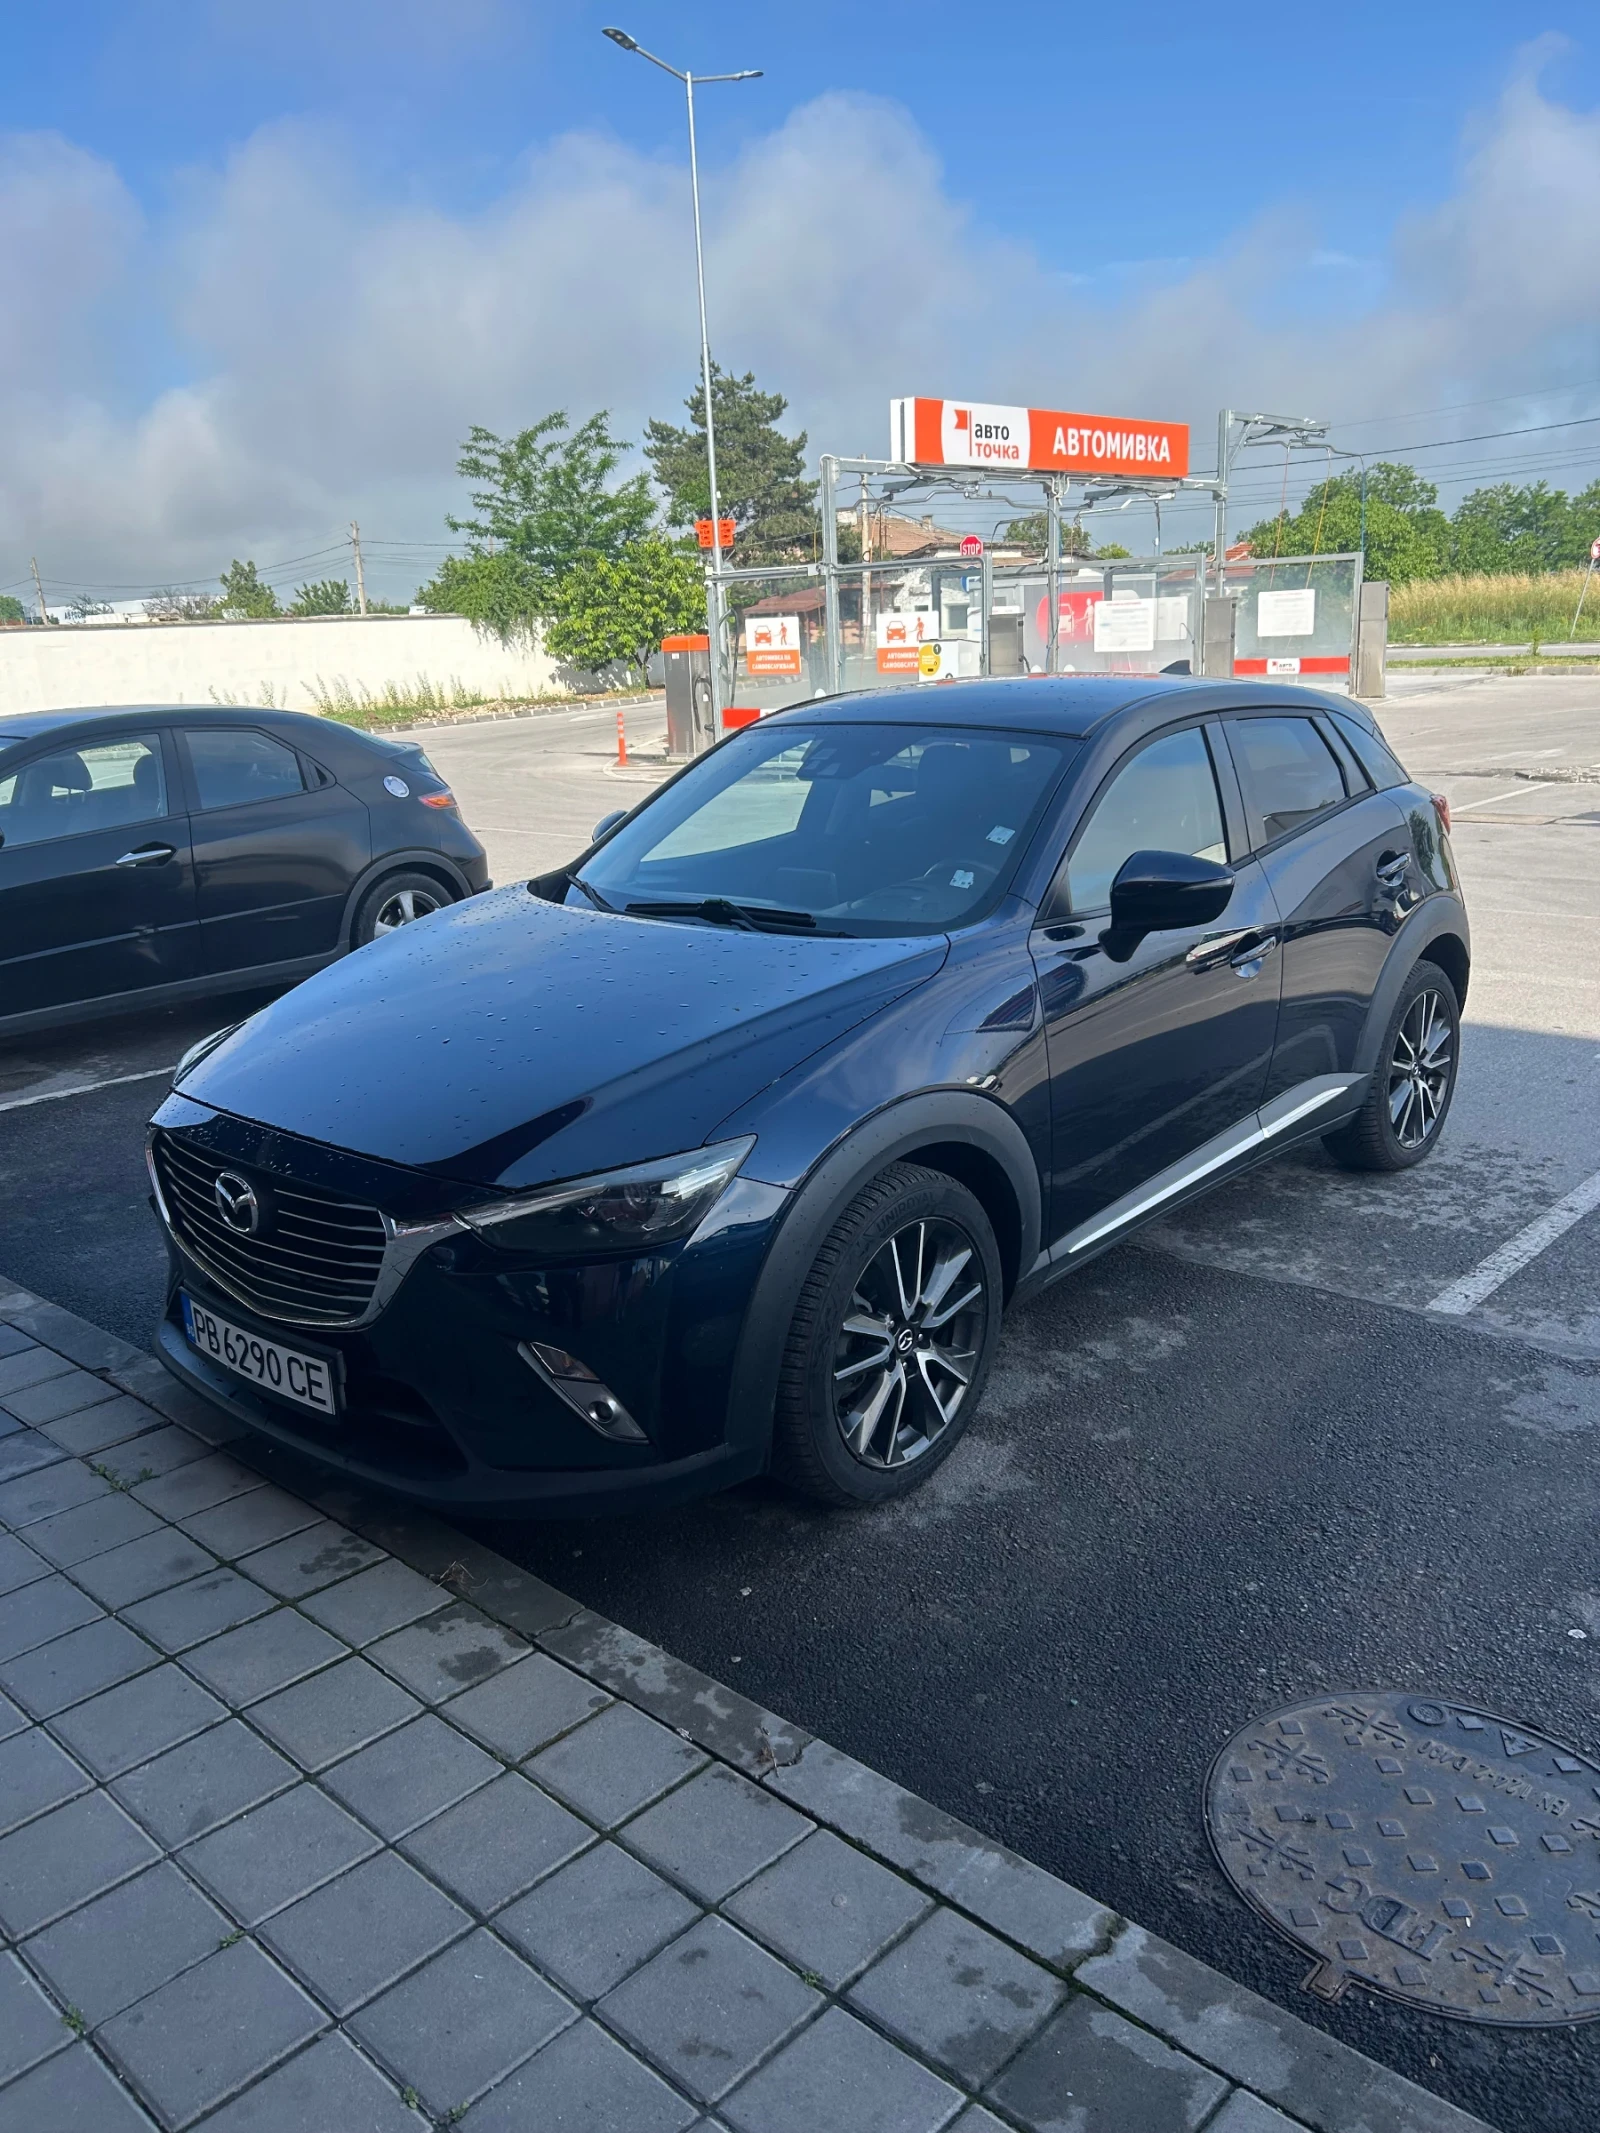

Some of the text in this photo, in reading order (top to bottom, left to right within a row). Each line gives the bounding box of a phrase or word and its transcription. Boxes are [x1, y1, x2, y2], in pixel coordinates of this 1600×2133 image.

[975, 421, 1010, 441] авто
[975, 441, 1020, 460] точка
[1052, 426, 1171, 463] АВТОМИВКА
[962, 543, 981, 556] STOP
[876, 1191, 937, 1233] UNIROYAL
[1539, 1793, 1569, 1817] EN
